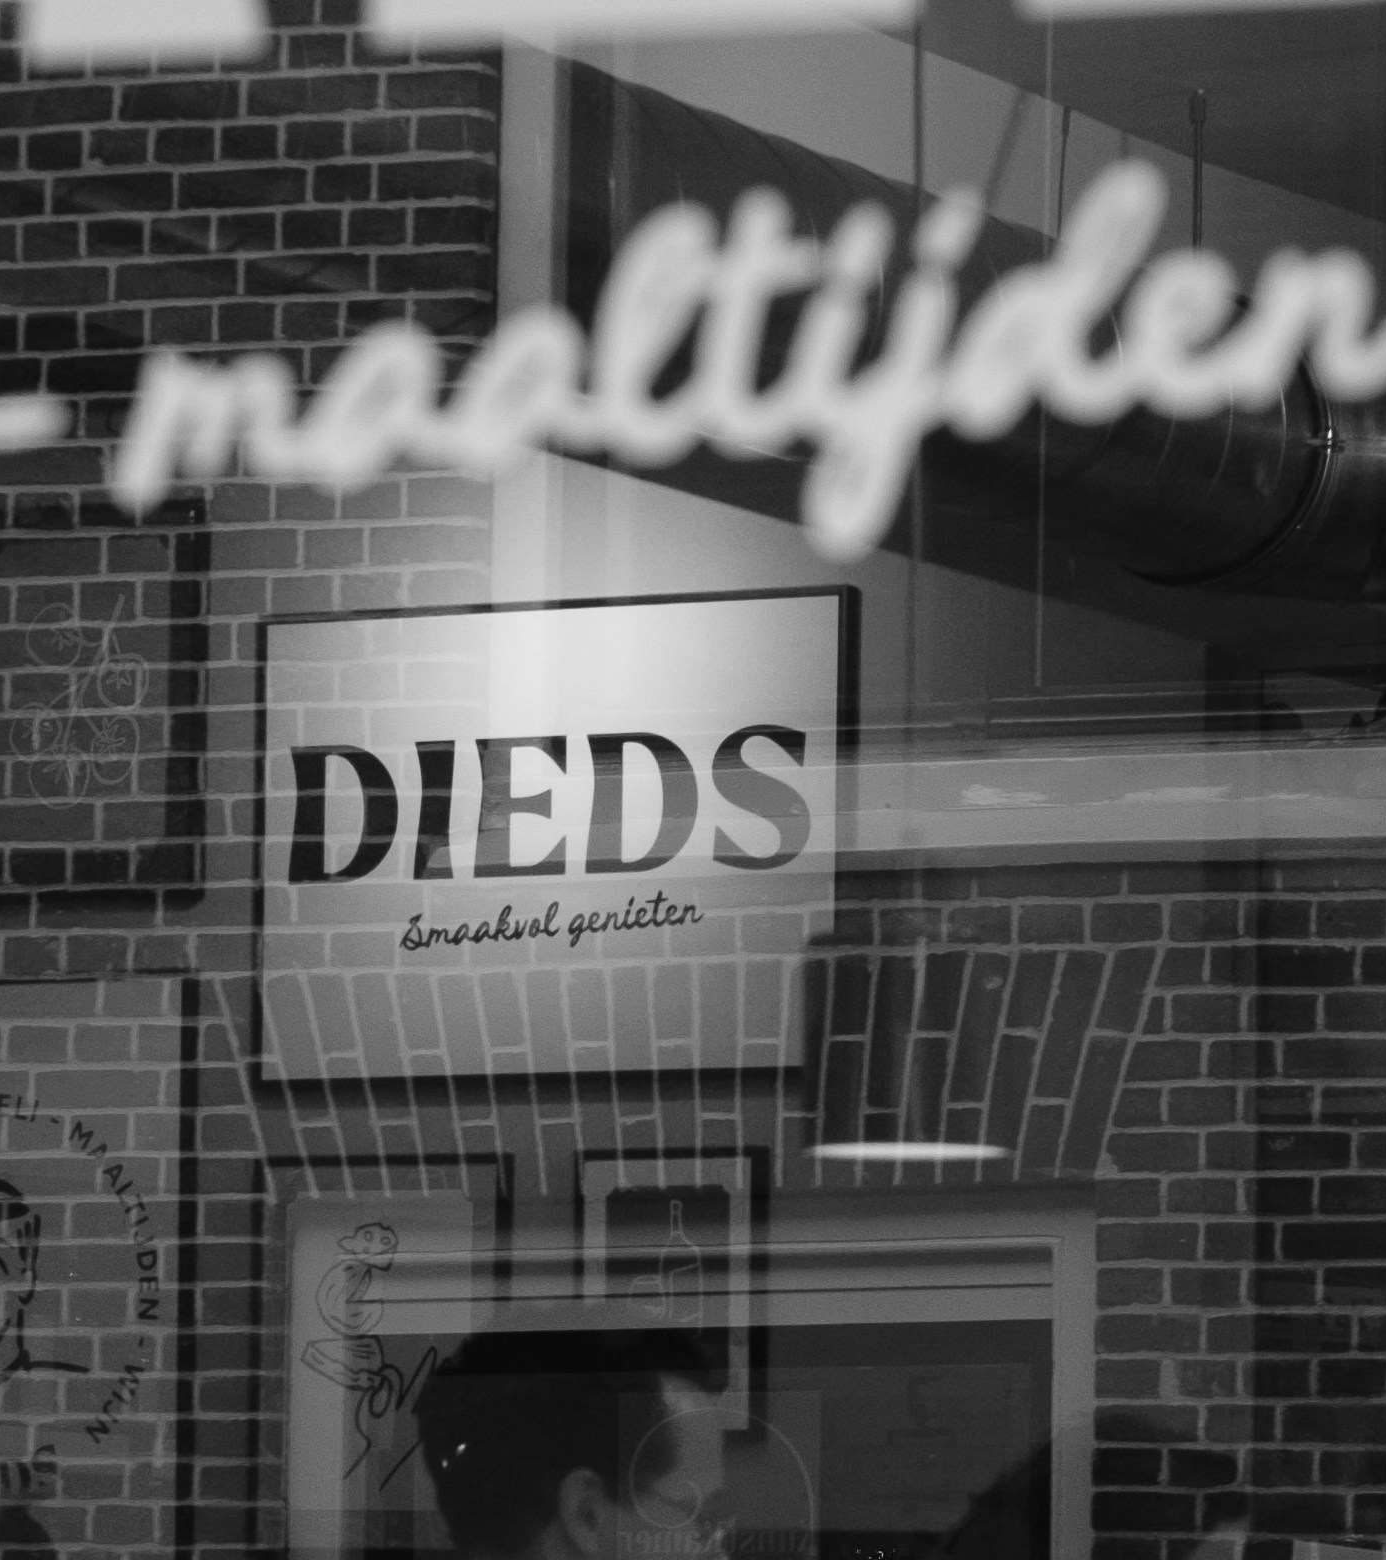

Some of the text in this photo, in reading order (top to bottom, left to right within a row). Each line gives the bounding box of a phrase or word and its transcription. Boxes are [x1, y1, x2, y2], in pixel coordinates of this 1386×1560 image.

[287, 723, 811, 886] DIEDS
[398, 889, 705, 952] Smaakvol genieten
